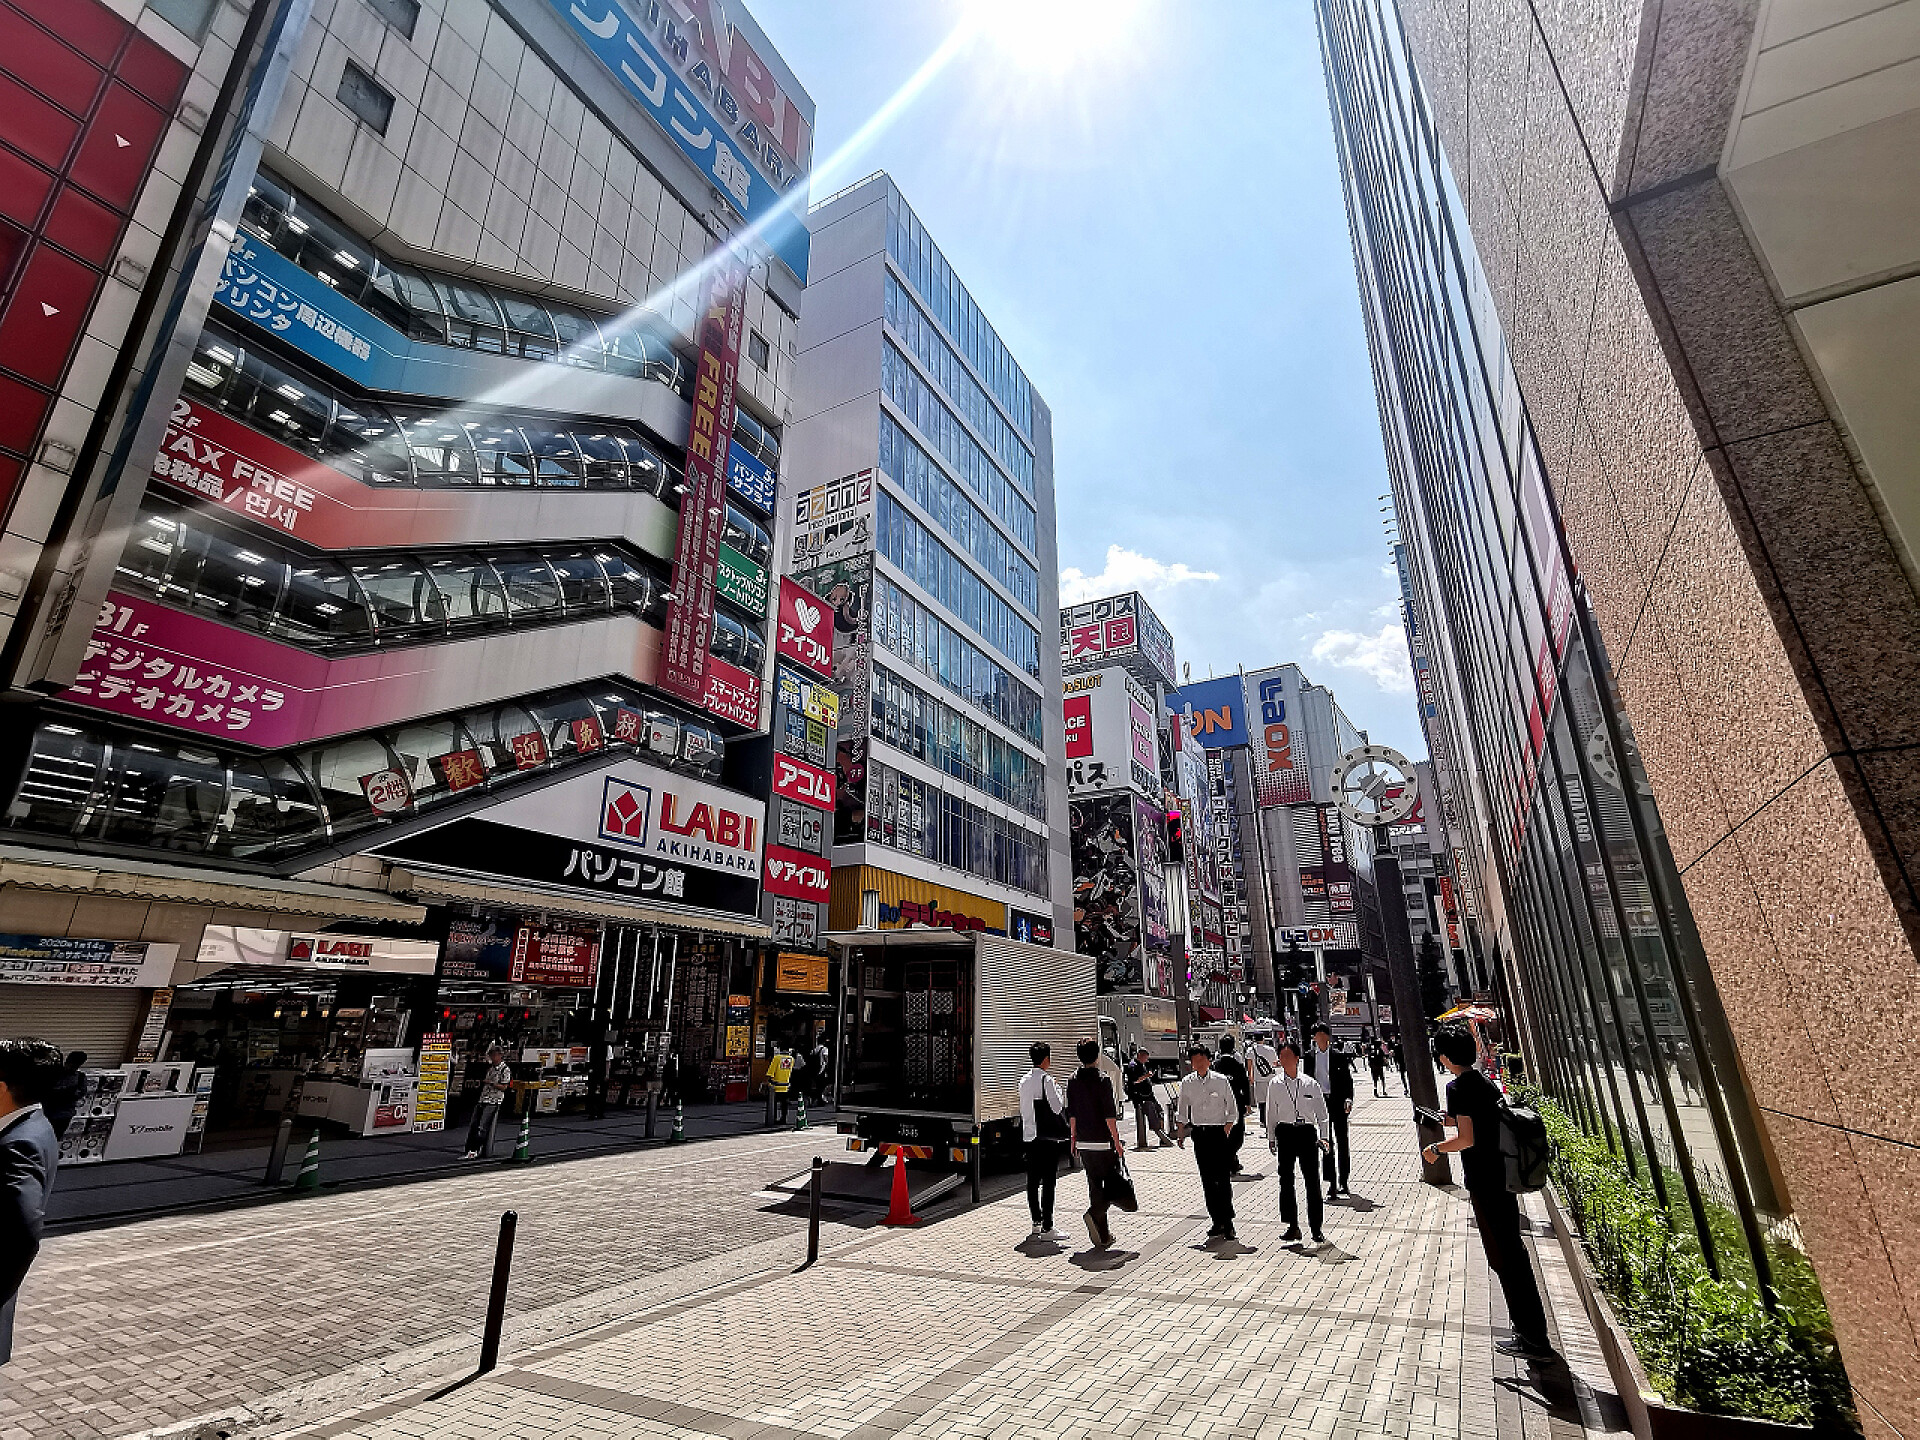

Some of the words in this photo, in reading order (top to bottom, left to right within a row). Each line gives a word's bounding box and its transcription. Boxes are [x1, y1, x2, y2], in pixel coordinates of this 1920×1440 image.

[232, 459, 316, 512] FREE
[781, 621, 830, 666] アイフル
[83, 639, 285, 711] デジタルカメラ
[1064, 715, 1086, 730] CE
[514, 737, 546, 766] 迎
[778, 760, 831, 804] アコム
[659, 791, 758, 853] LABI
[563, 848, 686, 898] パソコン館
[656, 838, 757, 873] AKIHABARA
[784, 861, 829, 891] アイフル
[316, 940, 374, 957] LABI
